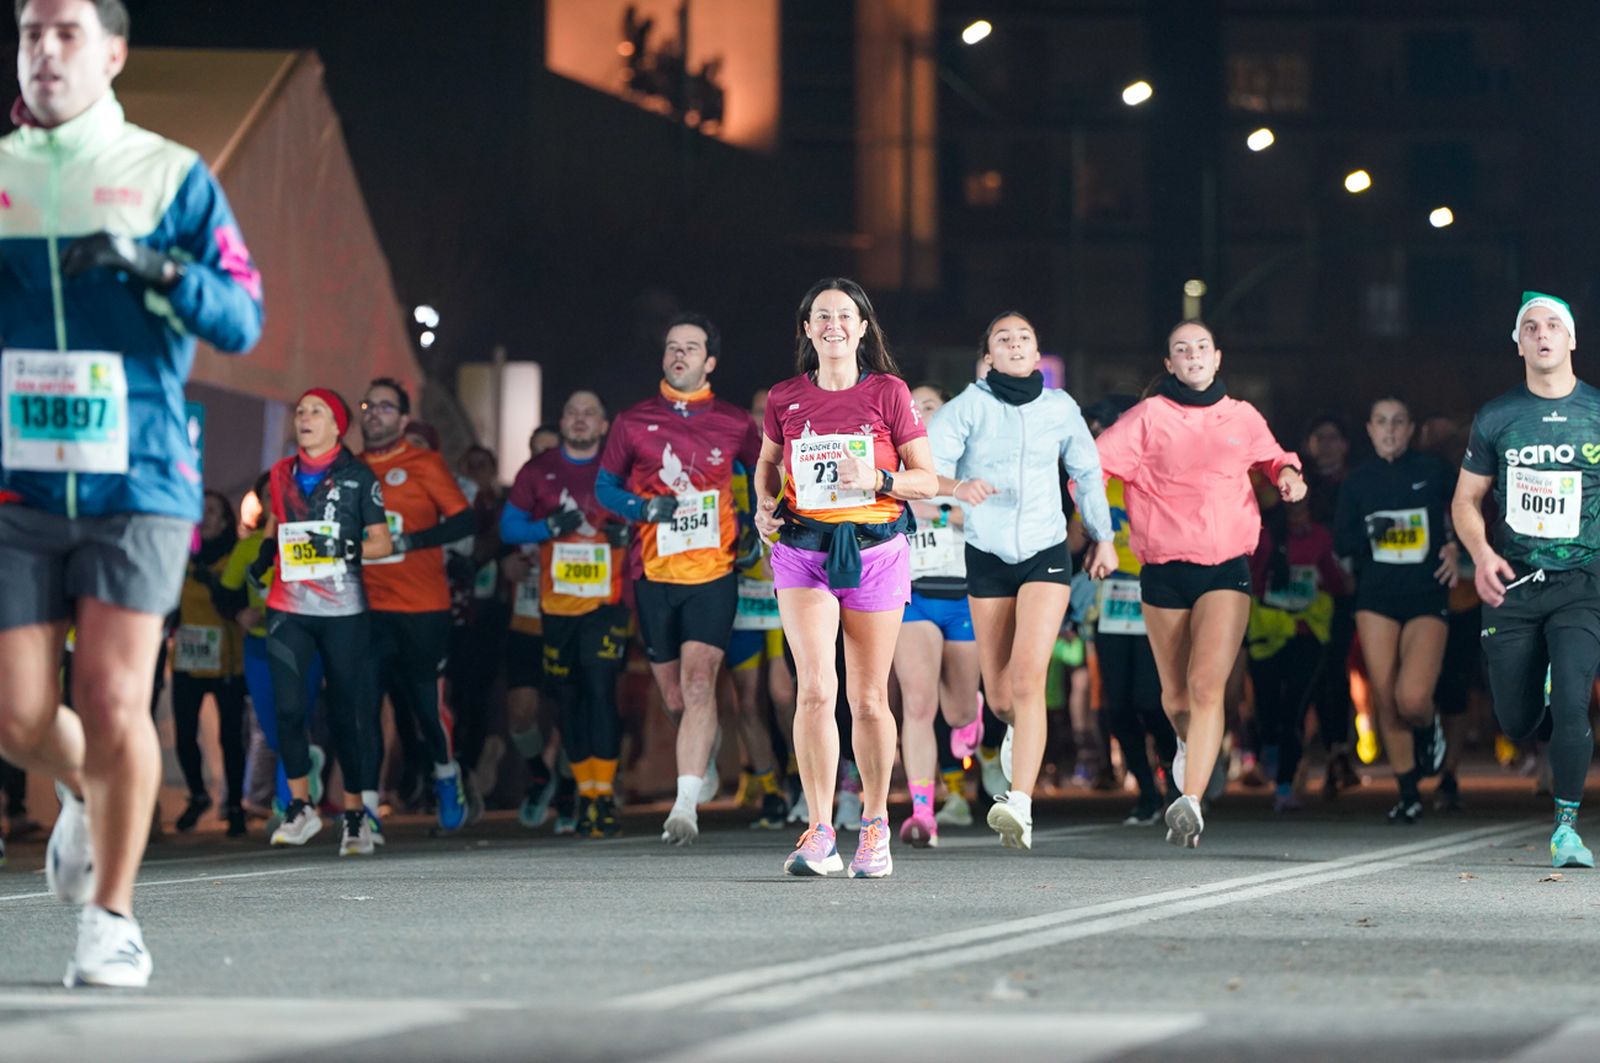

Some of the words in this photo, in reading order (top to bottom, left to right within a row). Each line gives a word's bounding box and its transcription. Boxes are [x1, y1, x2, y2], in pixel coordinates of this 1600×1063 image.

[21, 397, 107, 429] 13897
[800, 453, 815, 462] SAN
[1505, 444, 1575, 467] sano
[1521, 493, 1566, 515] 6091
[670, 512, 709, 533] 4354
[909, 532, 936, 549] 114
[564, 563, 599, 578] 2001
